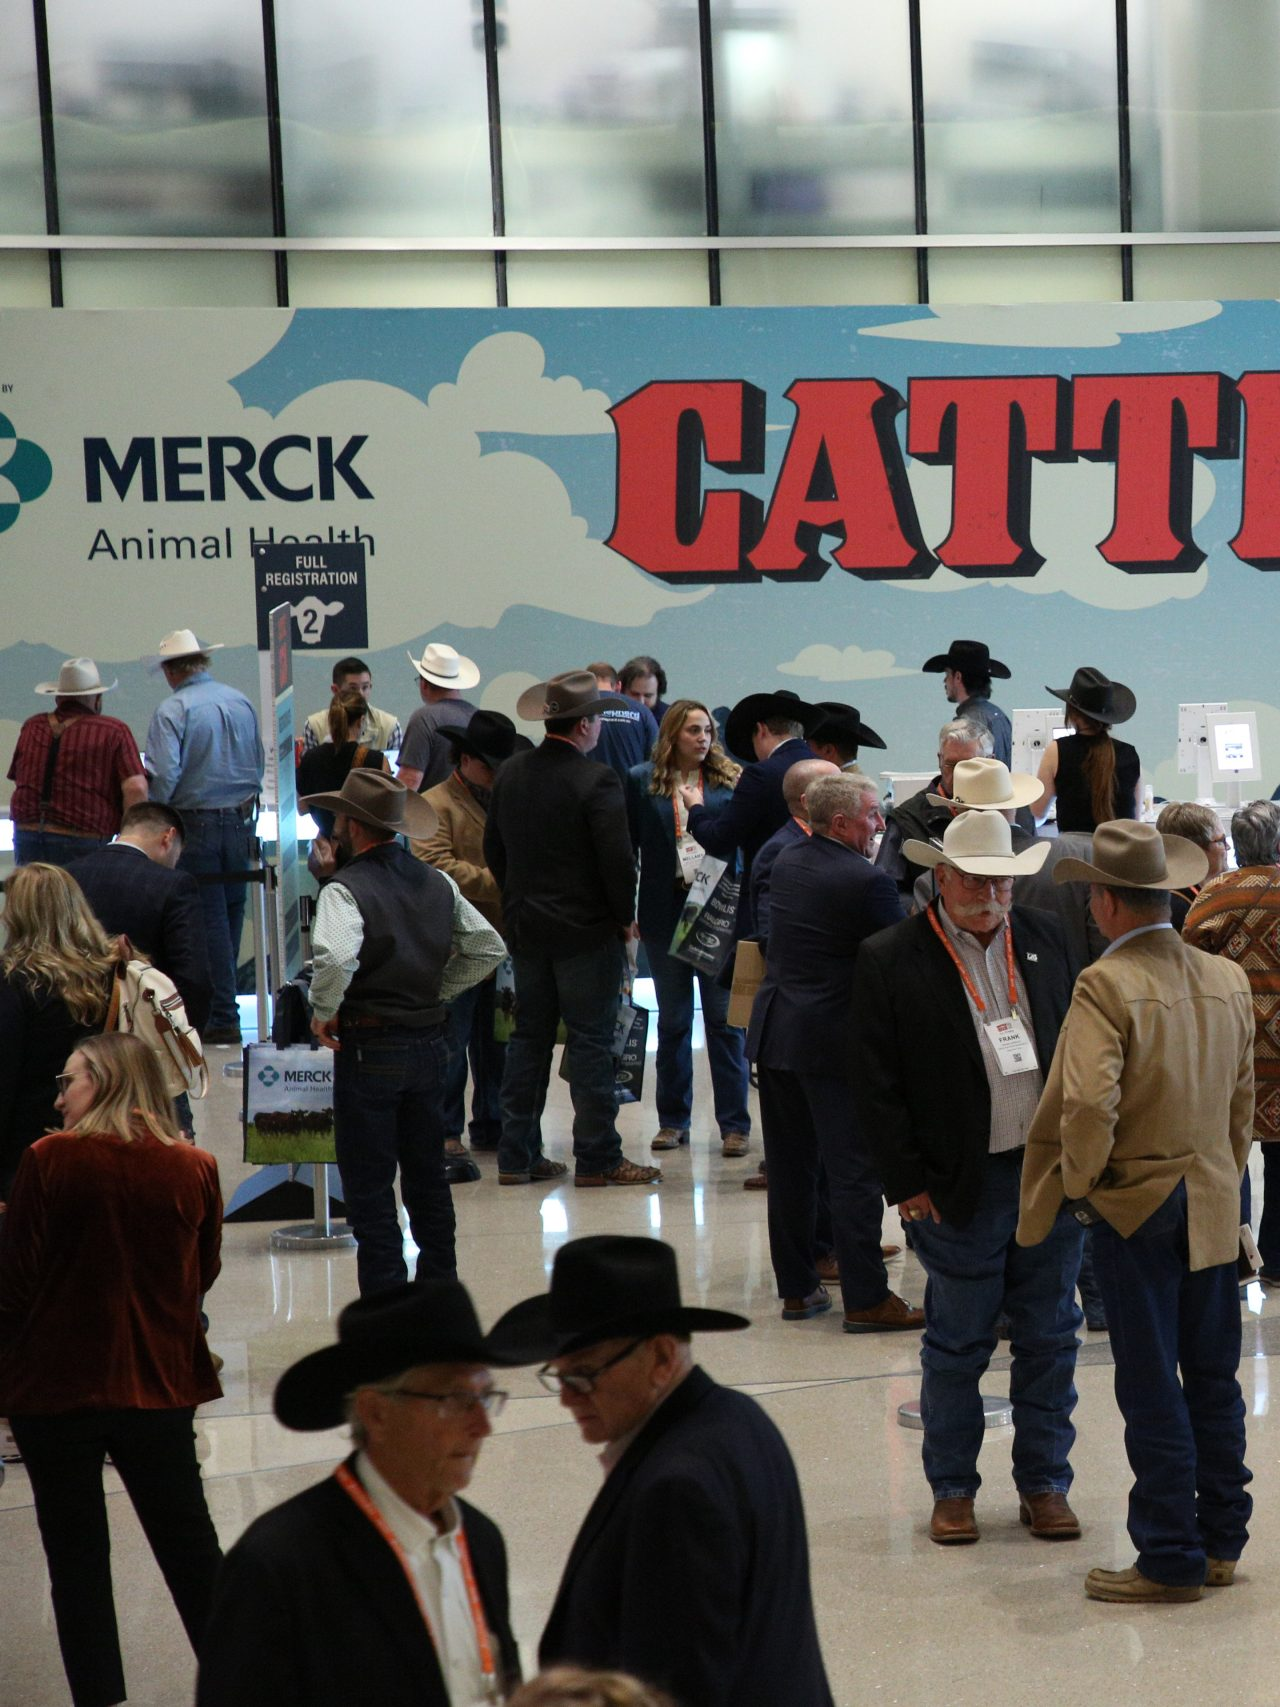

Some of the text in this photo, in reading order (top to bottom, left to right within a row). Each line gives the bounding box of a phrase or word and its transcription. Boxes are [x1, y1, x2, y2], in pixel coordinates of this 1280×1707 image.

[83, 434, 375, 503] MERCK
[87, 526, 233, 560] Animal
[295, 555, 328, 569] FULL
[265, 571, 358, 587] REGISTRATION
[302, 608, 319, 634] 2
[998, 1034, 1021, 1043] FRANK
[284, 1070, 332, 1083] MERCK
